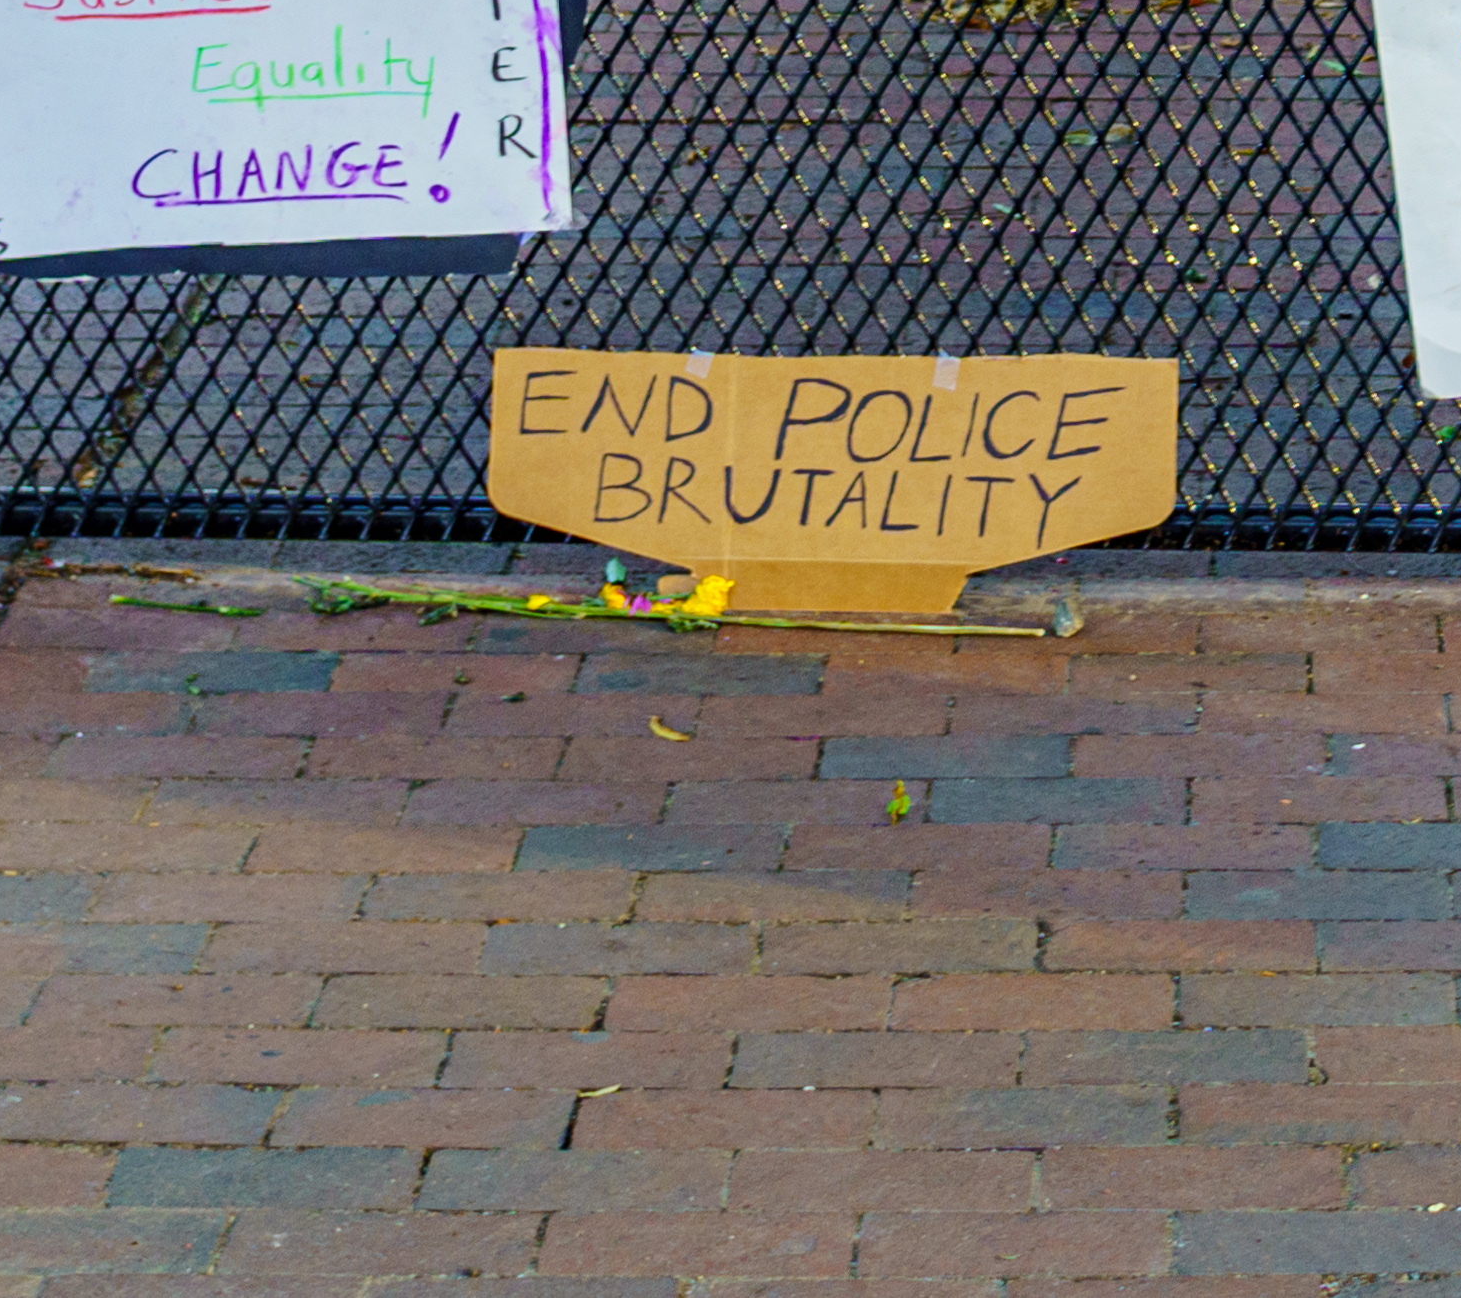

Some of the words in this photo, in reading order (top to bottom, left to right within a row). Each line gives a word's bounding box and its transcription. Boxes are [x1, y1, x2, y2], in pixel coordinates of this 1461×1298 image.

[519, 369, 713, 442] END
[775, 378, 1127, 463] POLICE
[594, 453, 1082, 549] BRUTALITY
